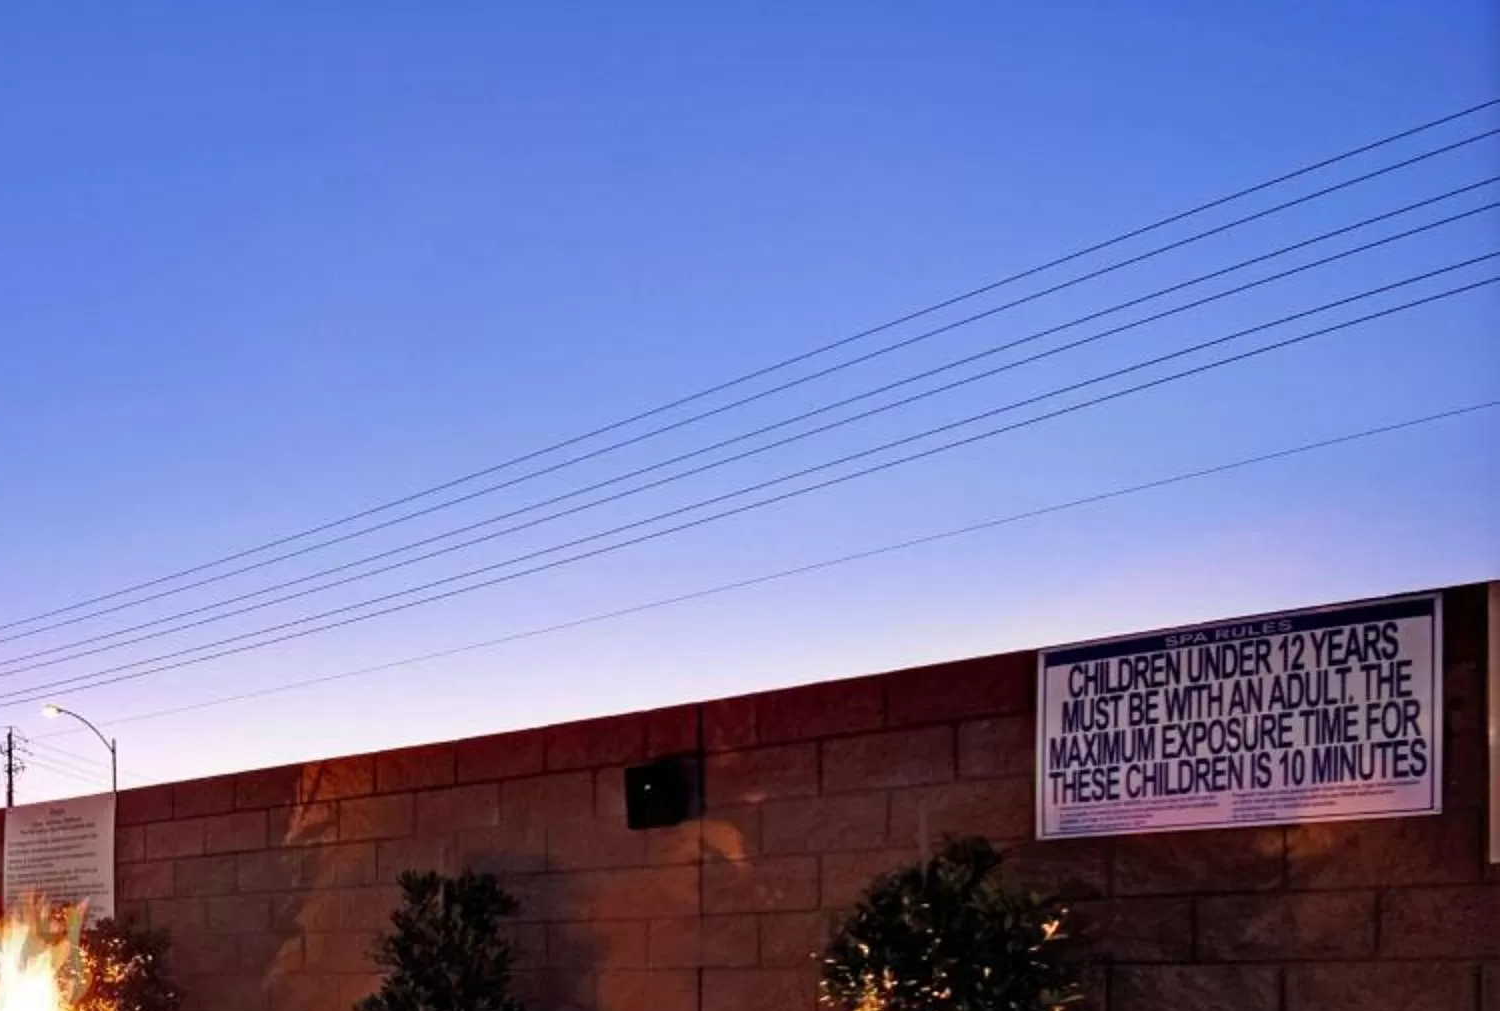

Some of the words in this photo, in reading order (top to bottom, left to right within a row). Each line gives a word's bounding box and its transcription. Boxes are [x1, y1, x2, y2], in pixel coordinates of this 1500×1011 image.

[1068, 651, 1181, 699] CHILDREN
[1187, 639, 1272, 682] UNDER
[1278, 634, 1305, 672] 12
[1310, 621, 1399, 668] YEARS
[1165, 632, 1208, 648] SPA
[1215, 619, 1293, 641] RULES
[1062, 694, 1124, 734] MUST
[1129, 690, 1159, 726] BE
[1164, 682, 1223, 722] WITH
[1228, 677, 1263, 716] AN
[1268, 666, 1353, 711] ADULT.
[1360, 660, 1413, 700] THE
[1050, 728, 1155, 769] MAXIMUM
[1161, 711, 1293, 759] EXPOSURE
[1299, 705, 1359, 746] TIME
[1366, 699, 1421, 740] FOR
[1049, 766, 1120, 805] THESE
[1126, 755, 1244, 798] CHILDREN
[1251, 752, 1272, 789] IS
[1279, 749, 1305, 786] 10
[1311, 738, 1427, 784] MINUTES
